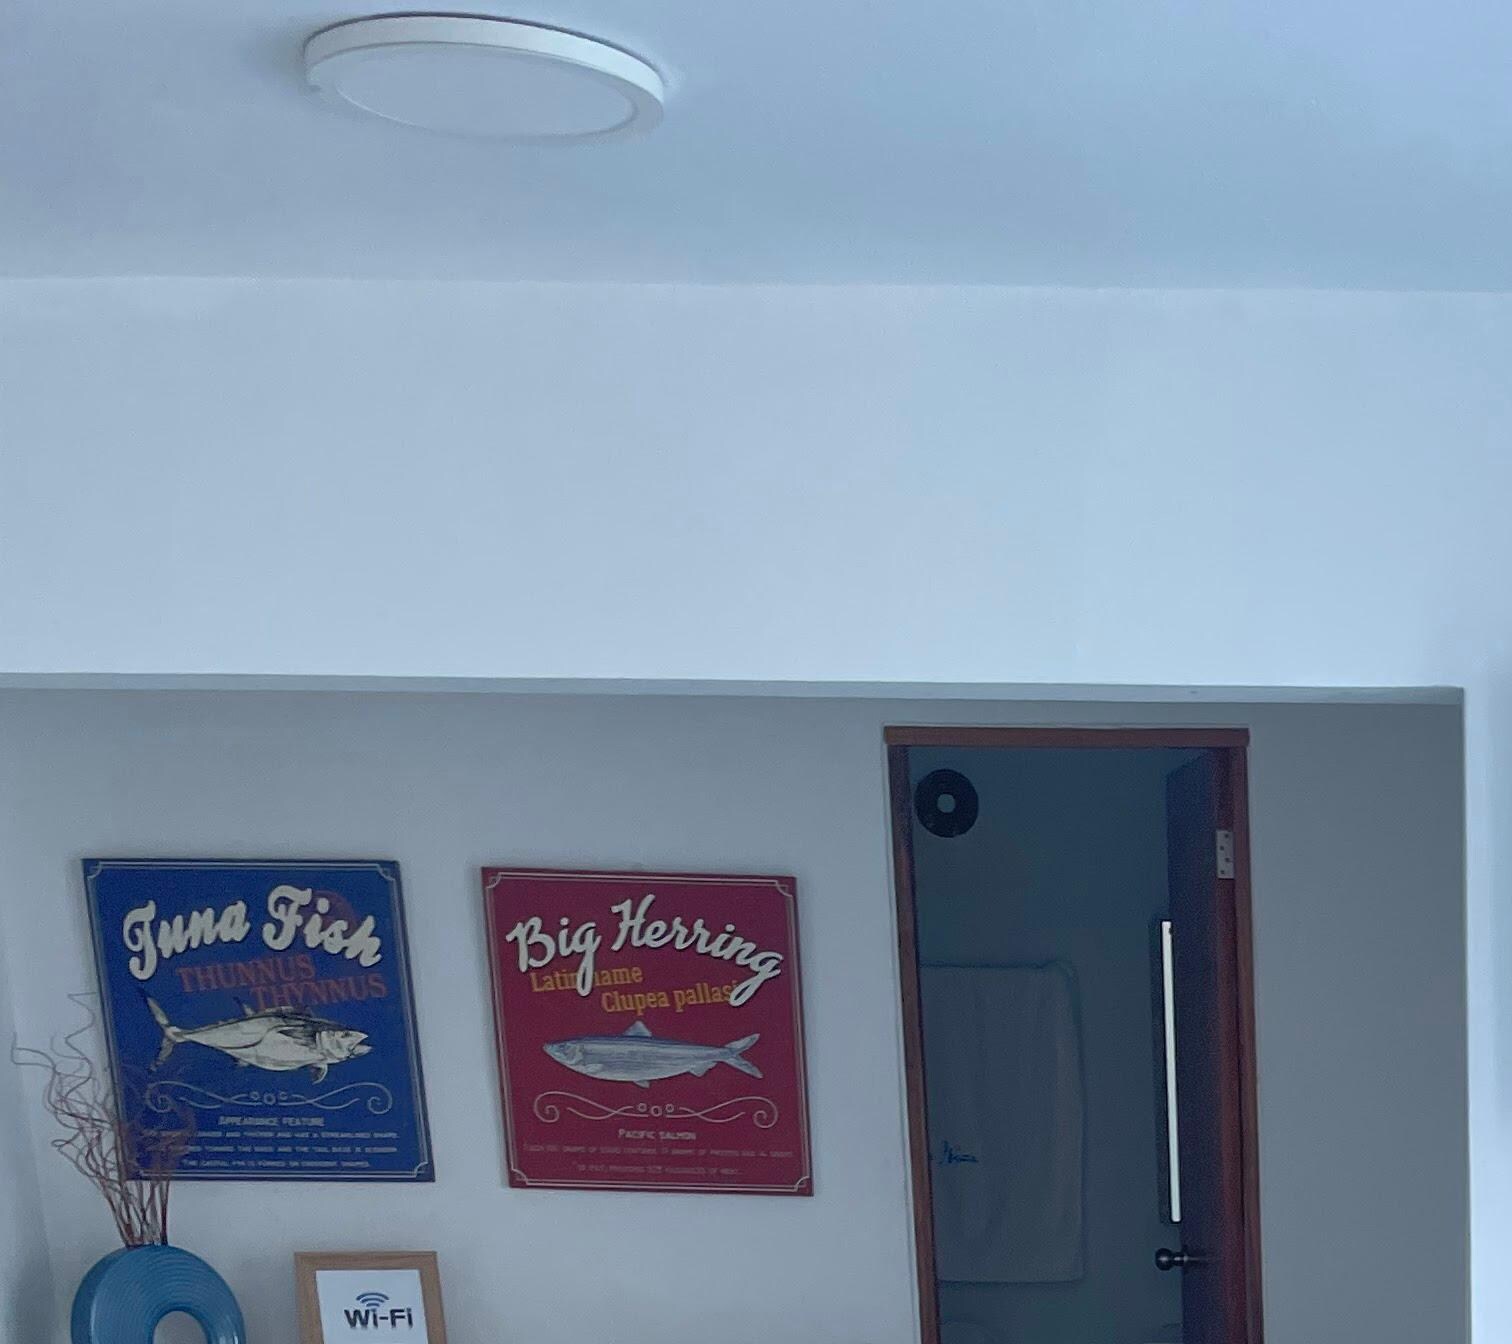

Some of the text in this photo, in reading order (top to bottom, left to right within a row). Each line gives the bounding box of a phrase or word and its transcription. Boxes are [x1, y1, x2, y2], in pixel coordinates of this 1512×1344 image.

[123, 885, 383, 980] Tuna Fish
[506, 894, 783, 1007] Big Herring
[176, 953, 316, 993] THUNNUS
[601, 990, 670, 1017] Clupea
[343, 1307, 413, 1329] Wi-Fi
